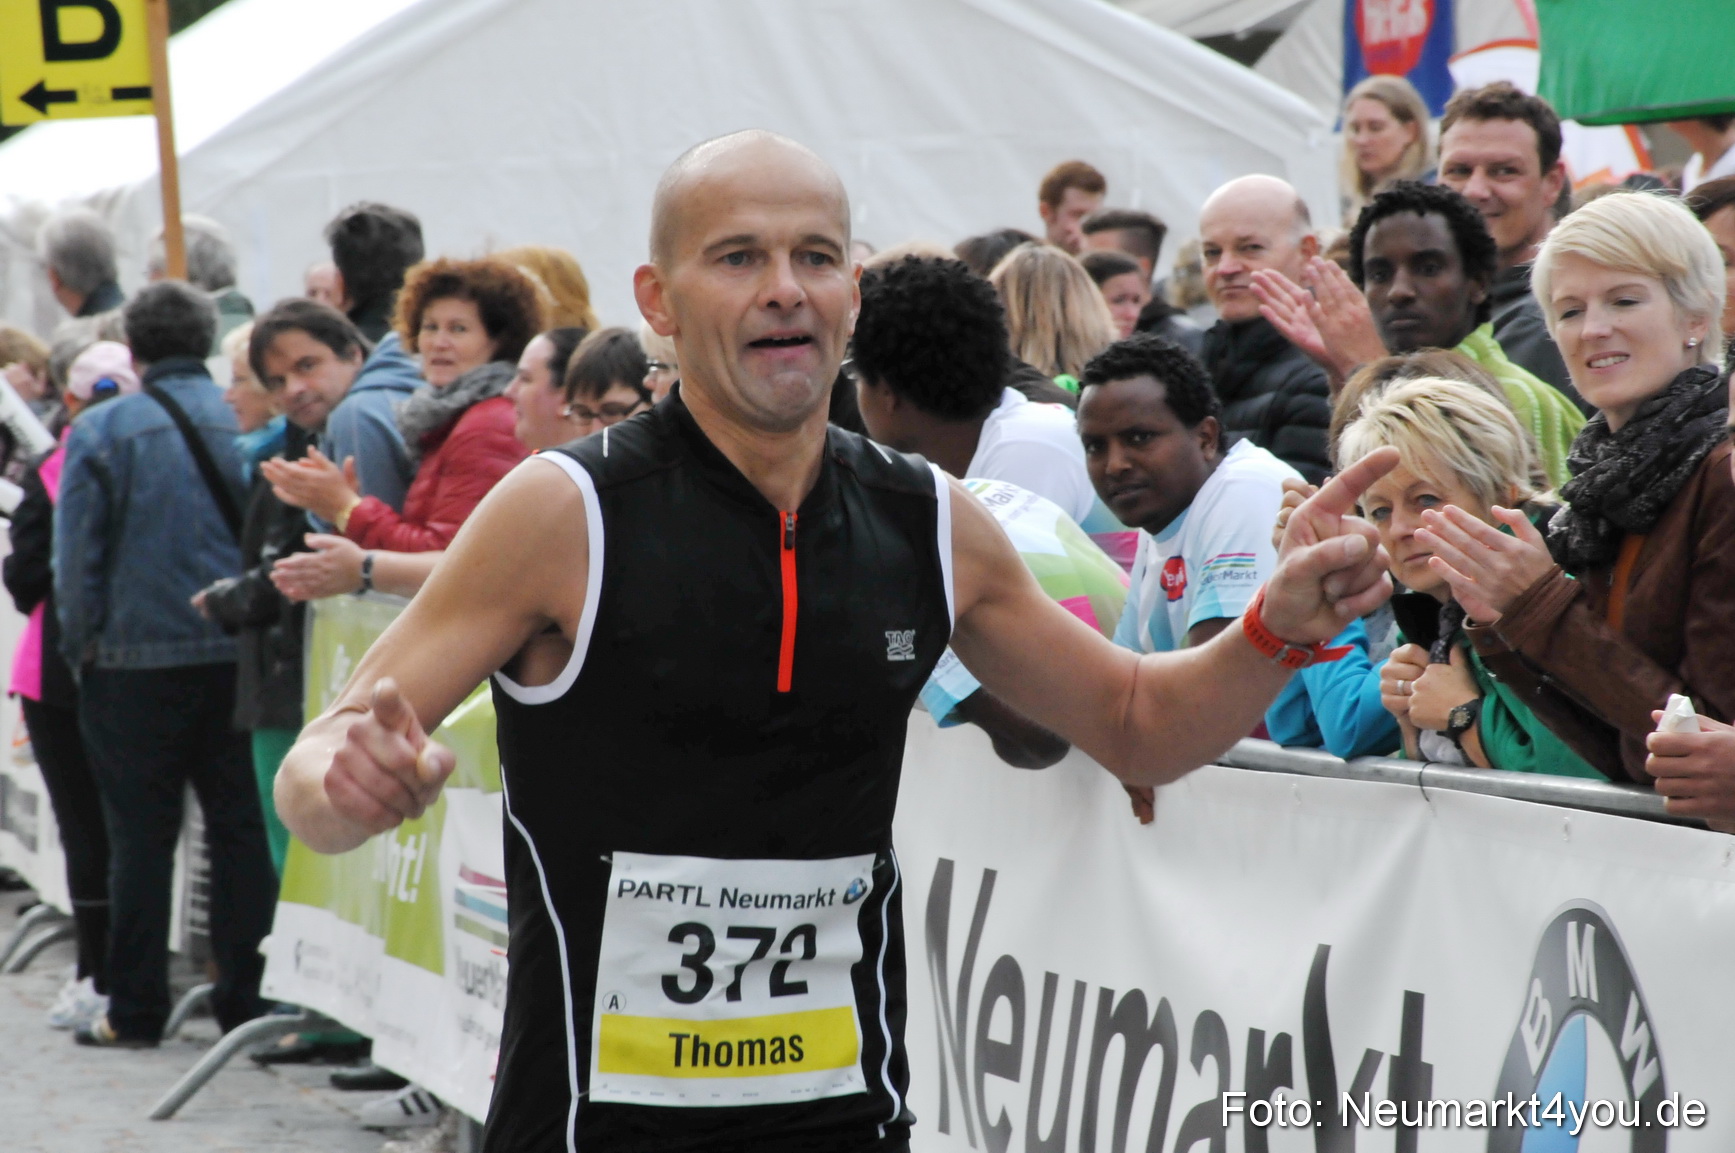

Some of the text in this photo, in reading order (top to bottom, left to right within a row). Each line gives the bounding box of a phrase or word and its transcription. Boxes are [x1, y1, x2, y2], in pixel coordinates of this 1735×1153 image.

[617, 878, 836, 910] PARTL Neumarkt
[661, 921, 817, 1005] 372
[925, 856, 1434, 1153] Neumarkt
[669, 1032, 804, 1068] Thomas
[1520, 921, 1659, 1101] BMW
